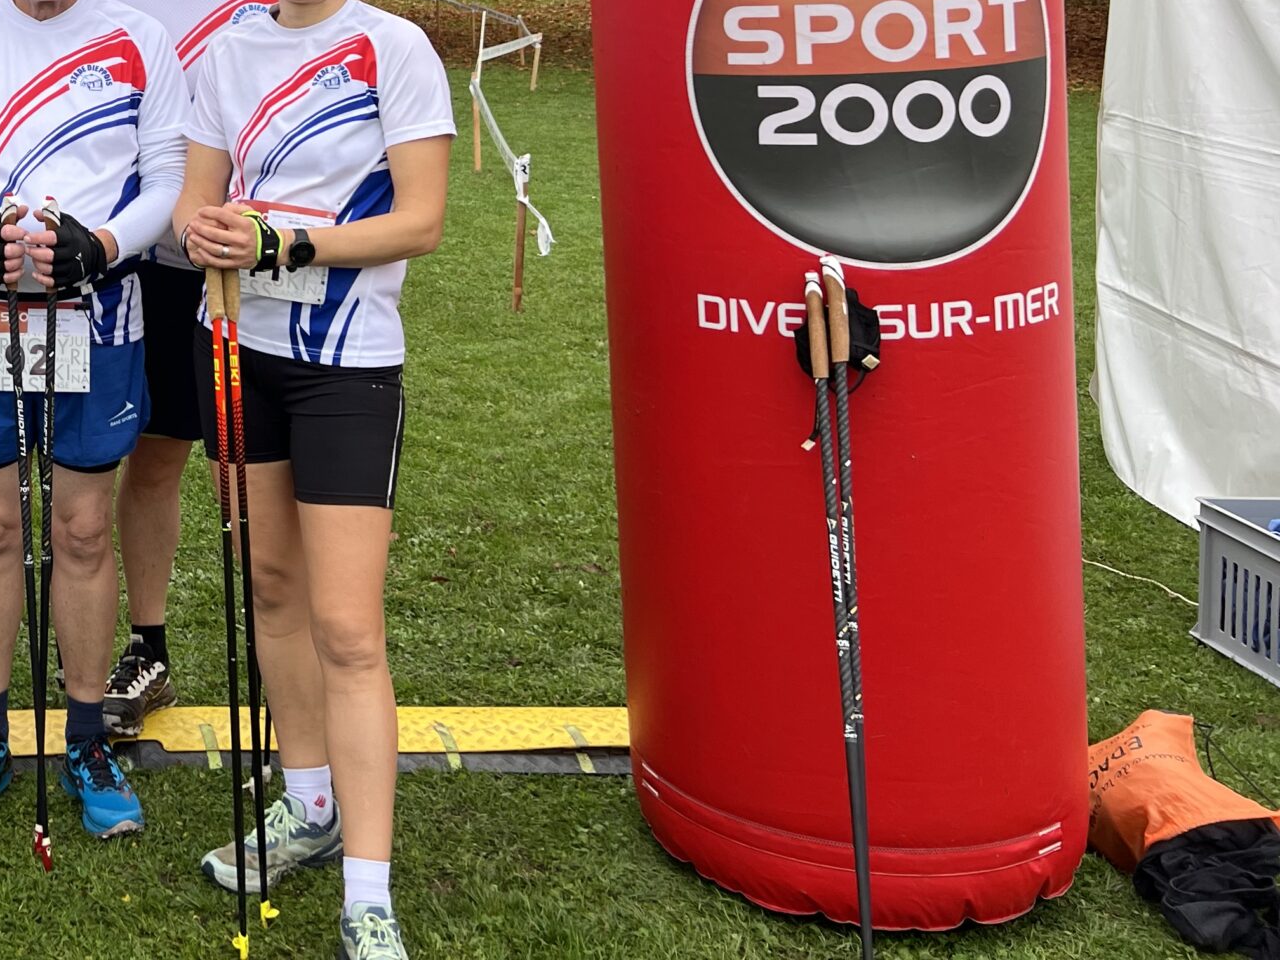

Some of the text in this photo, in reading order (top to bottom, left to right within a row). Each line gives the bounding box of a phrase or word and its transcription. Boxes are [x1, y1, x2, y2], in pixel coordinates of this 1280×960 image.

[70, 64, 113, 87] STADE DIEPPOIS
[756, 74, 1011, 146] 2000
[5, 343, 47, 376] 92
[228, 341, 240, 386] LEKI
[16, 399, 27, 457] GUIDETTI
[829, 533, 844, 603] GUIDETTI
